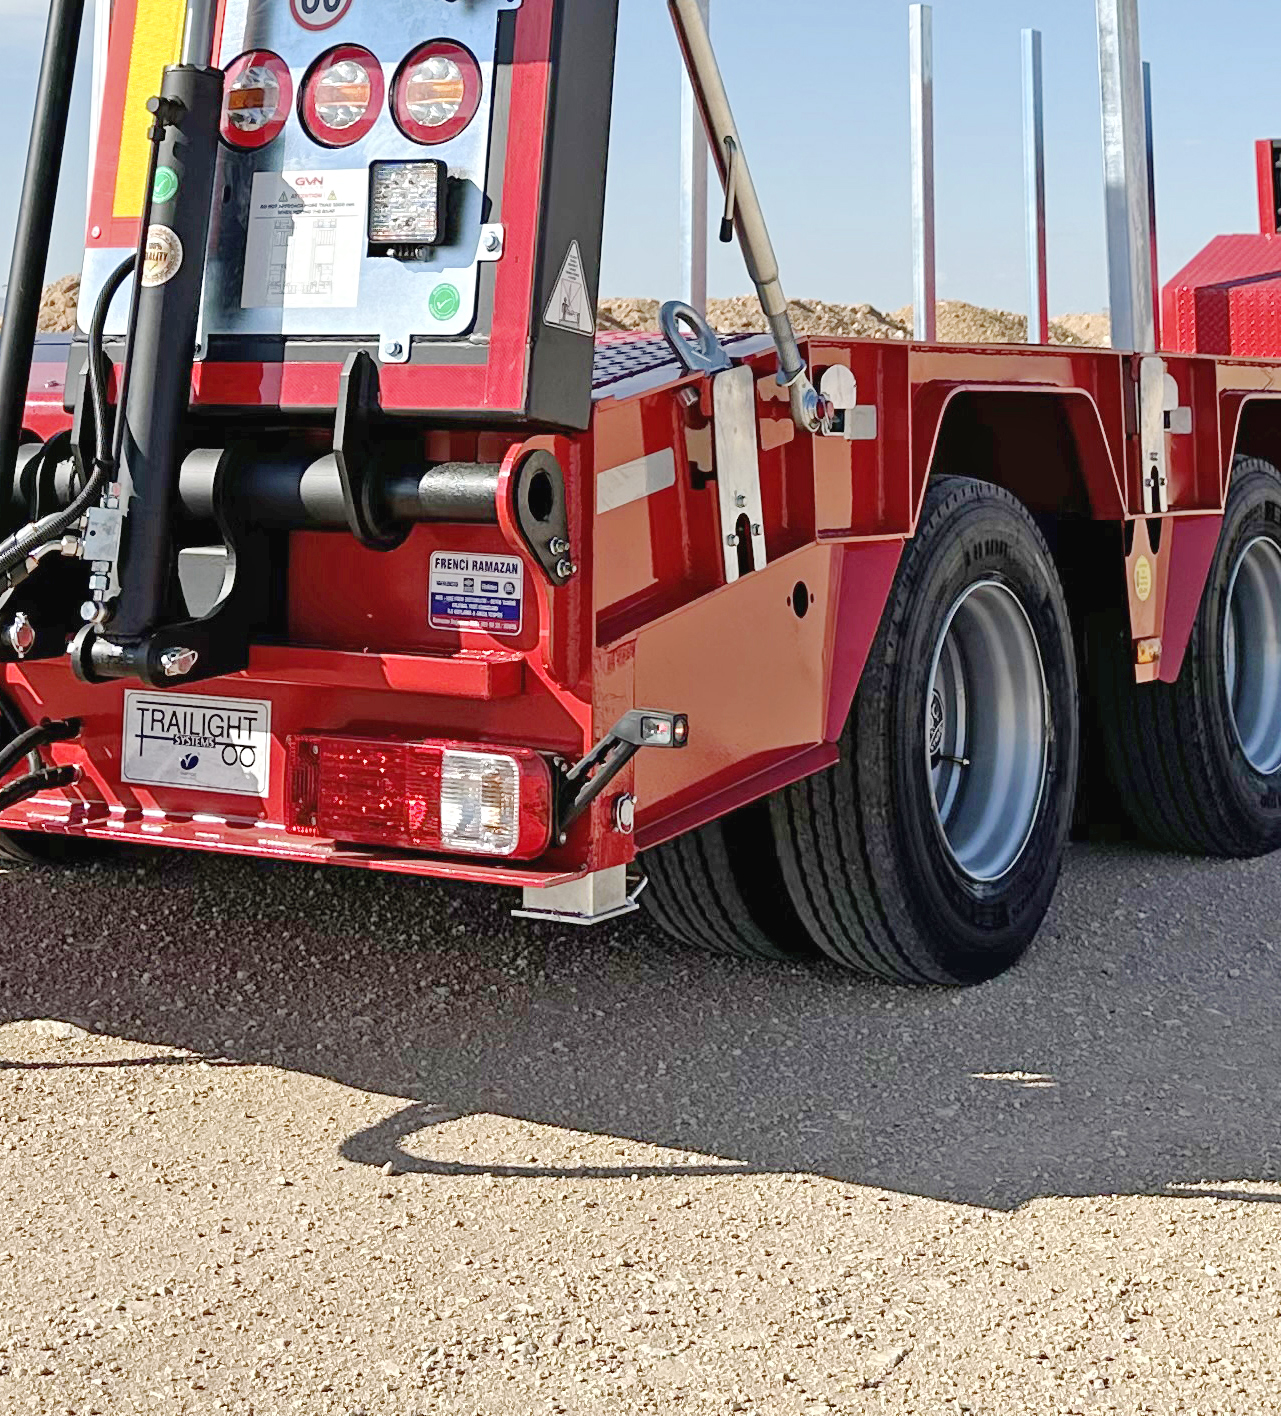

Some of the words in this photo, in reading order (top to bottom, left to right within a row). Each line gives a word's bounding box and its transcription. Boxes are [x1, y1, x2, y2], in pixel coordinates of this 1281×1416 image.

[295, 176, 324, 186] GVN
[471, 560, 518, 575] RAMAZAN
[136, 707, 258, 741] TRAILIGHT
[173, 734, 216, 748] SYSTEMS
